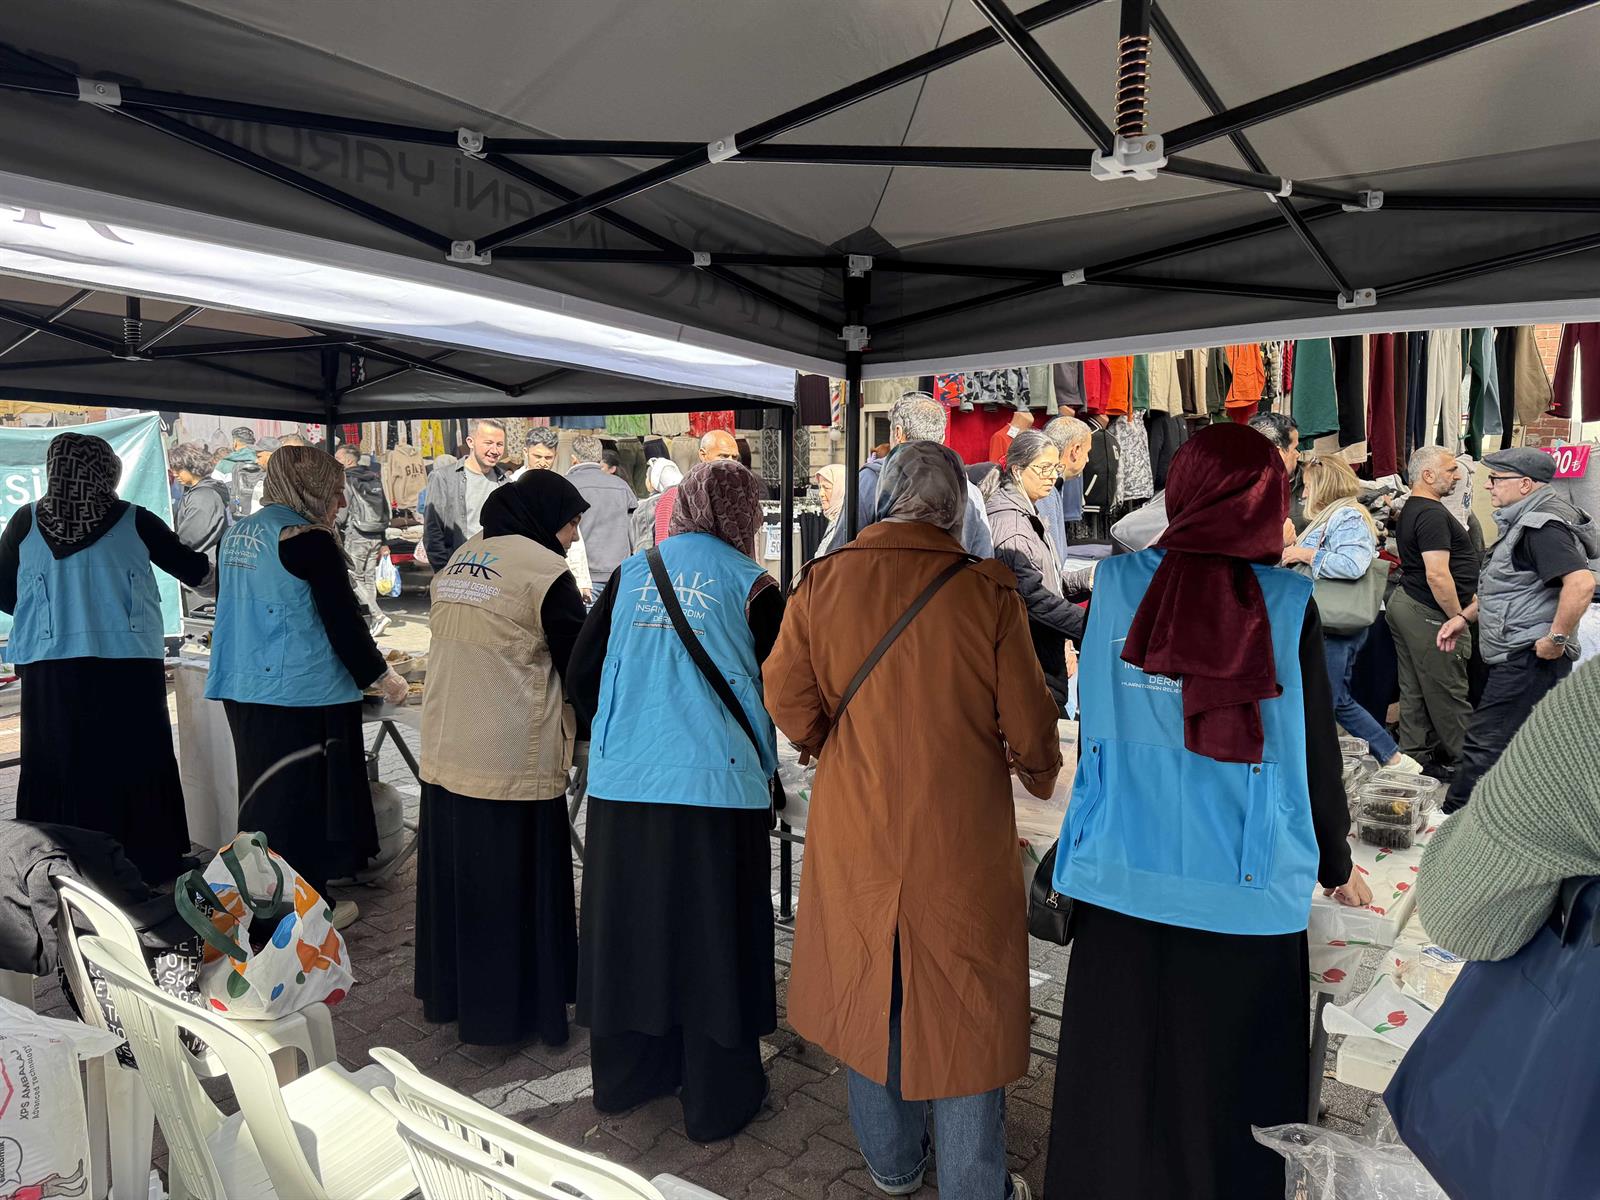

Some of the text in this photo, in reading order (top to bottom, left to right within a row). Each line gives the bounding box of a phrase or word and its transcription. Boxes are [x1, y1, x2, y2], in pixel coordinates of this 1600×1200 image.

[446, 550, 501, 580] HAK
[10, 1048, 31, 1121] XPS AMBALAJ
[22, 1044, 40, 1085] Technology
